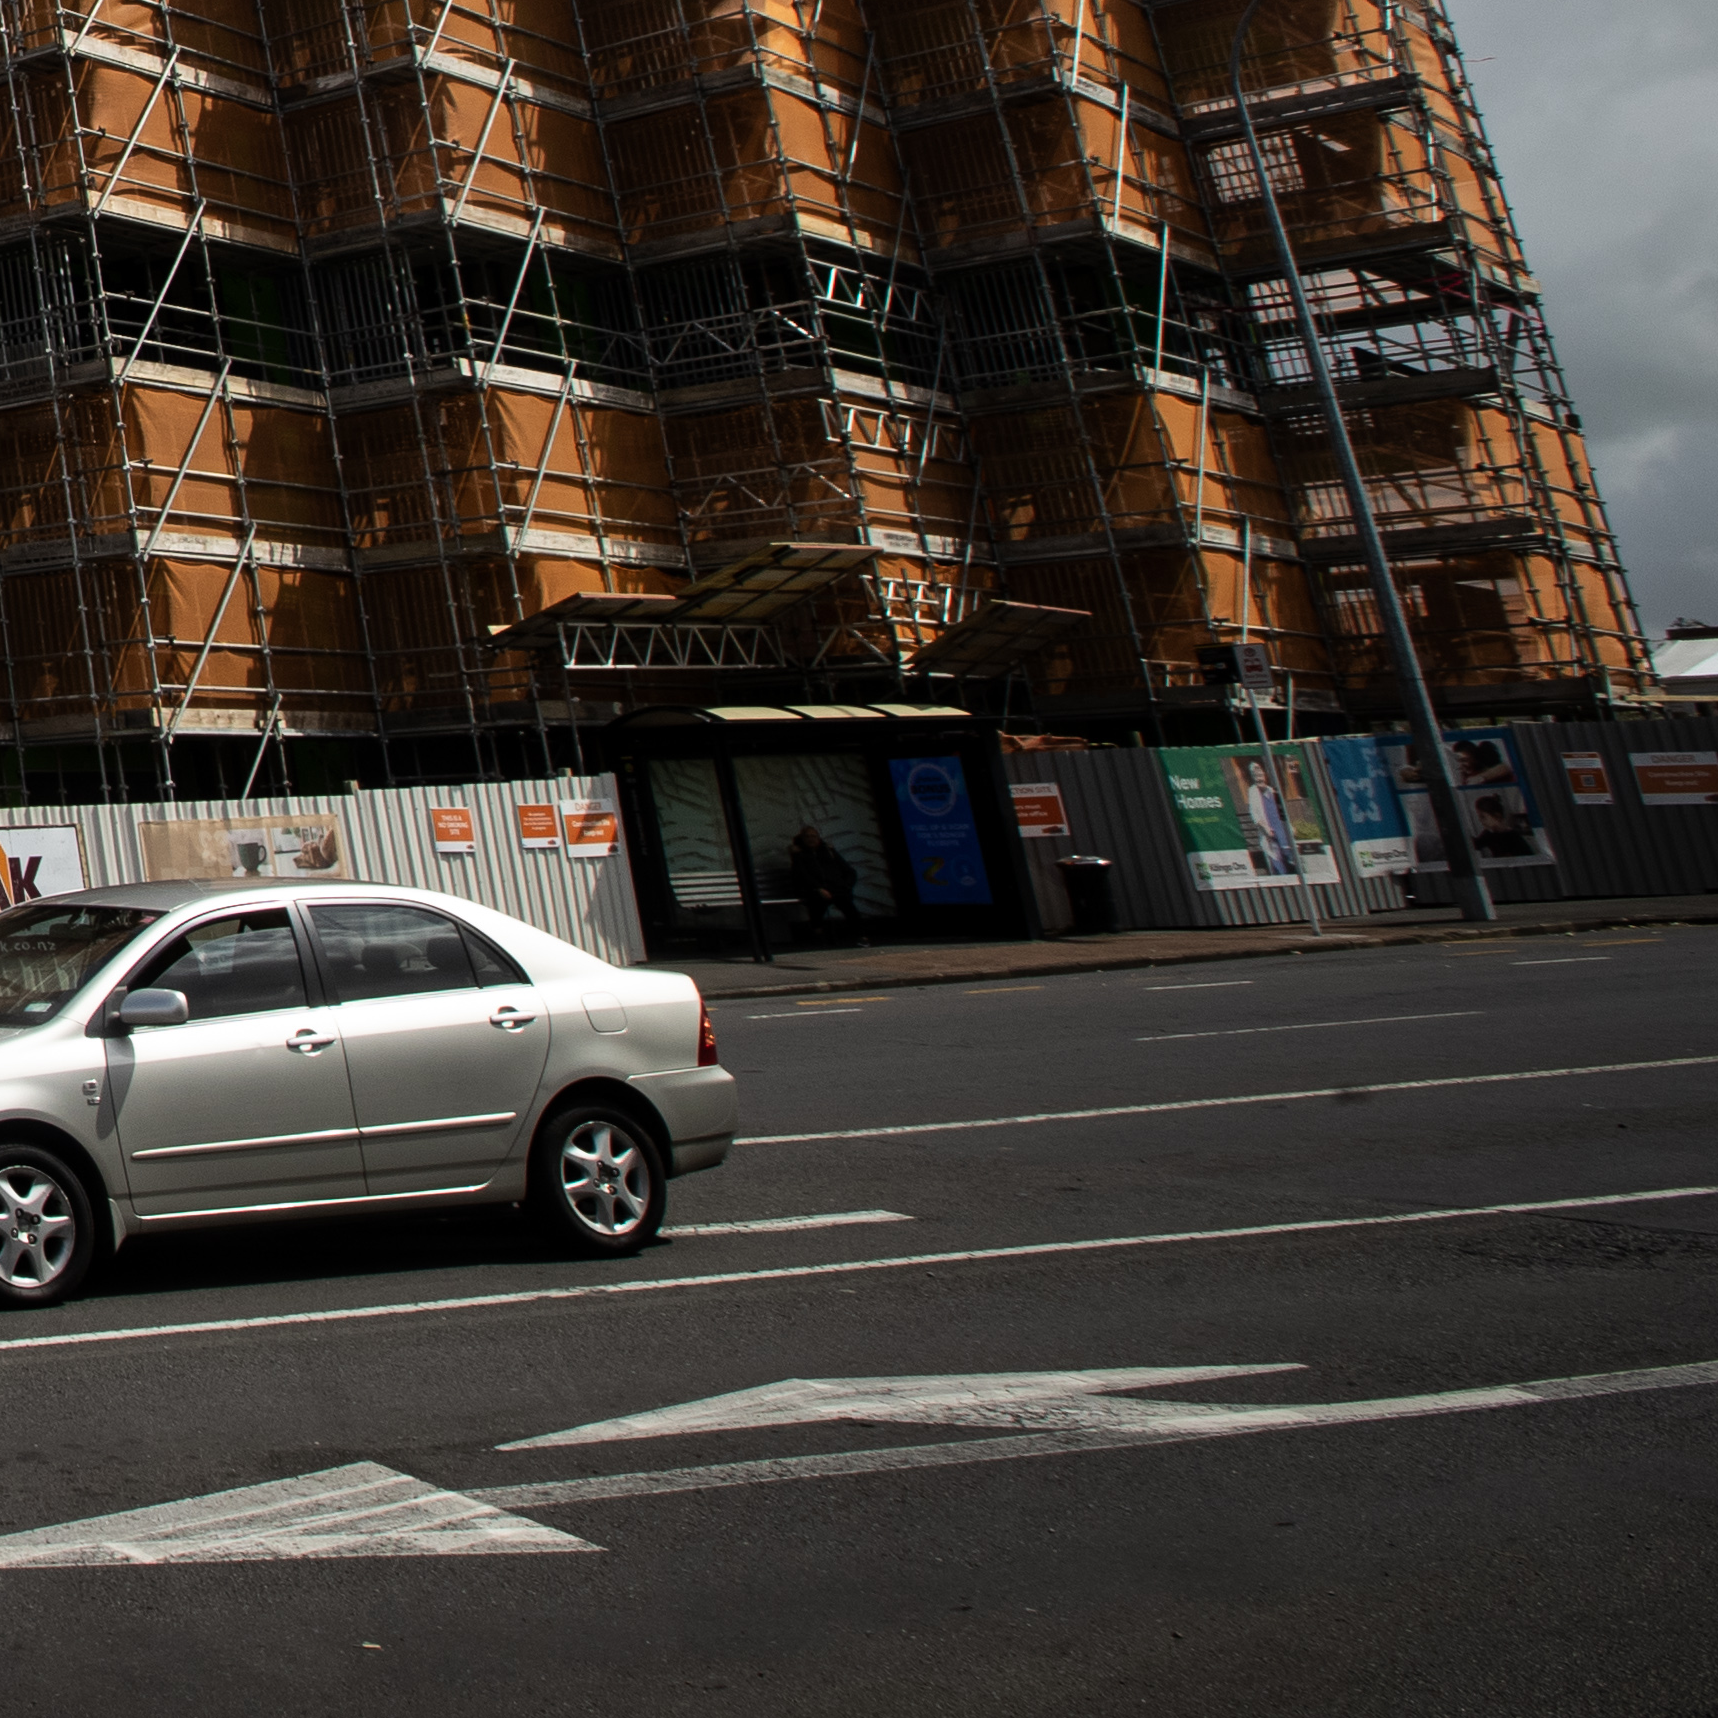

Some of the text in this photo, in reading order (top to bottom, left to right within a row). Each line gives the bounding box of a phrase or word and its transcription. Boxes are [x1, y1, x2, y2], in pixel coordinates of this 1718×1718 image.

[1652, 755, 1696, 763] DANGER
[1169, 775, 1200, 790] New
[1174, 793, 1224, 809] Homes
